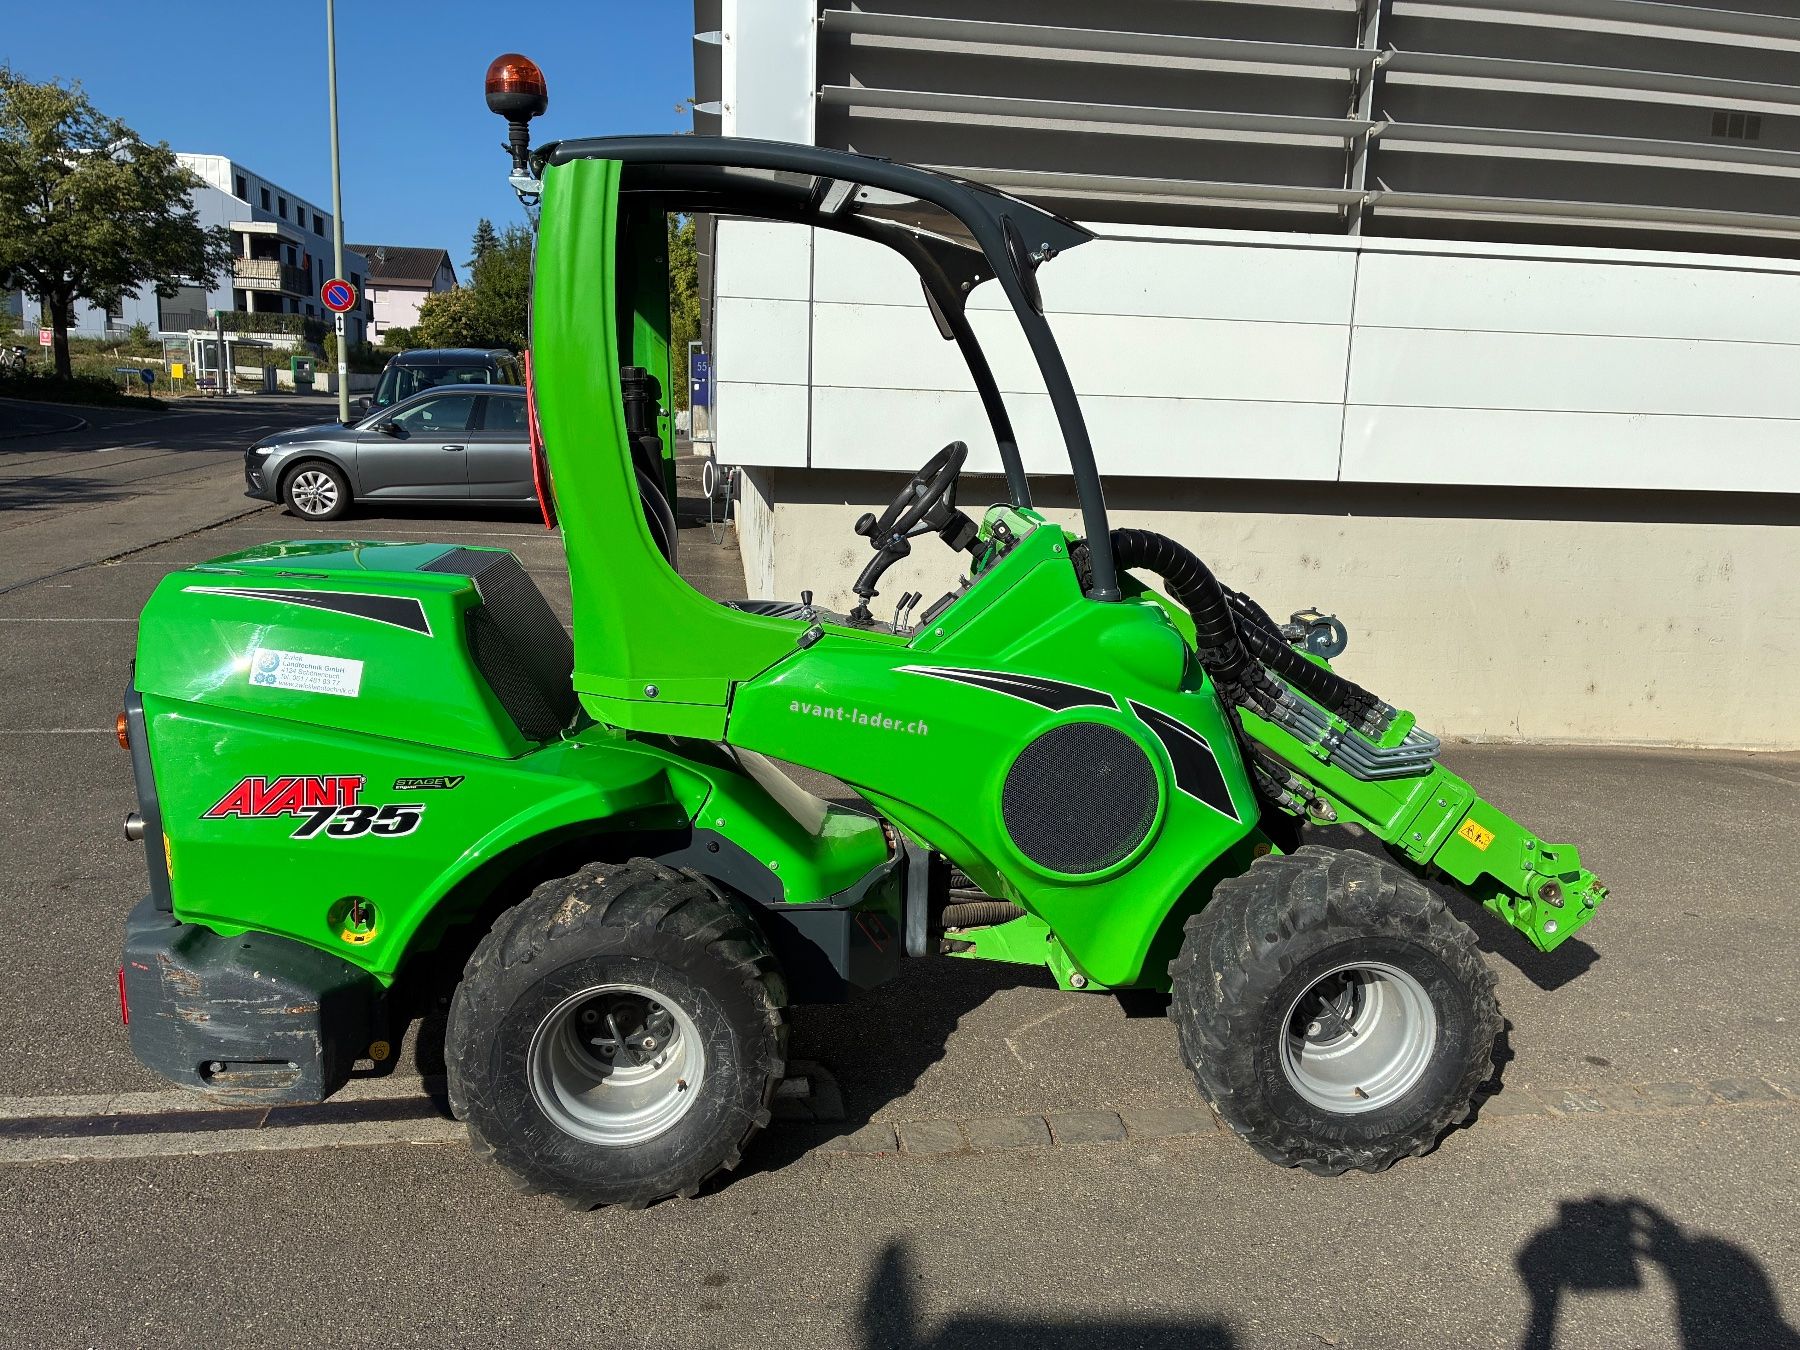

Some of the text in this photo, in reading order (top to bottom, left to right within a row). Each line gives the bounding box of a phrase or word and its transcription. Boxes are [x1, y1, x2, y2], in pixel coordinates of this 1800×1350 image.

[697, 361, 707, 372] 55
[282, 661, 345, 673] Landtechnik GmbH
[789, 700, 929, 736] avant-lader.ch
[201, 776, 363, 819] AVANT
[289, 803, 426, 840] 735
